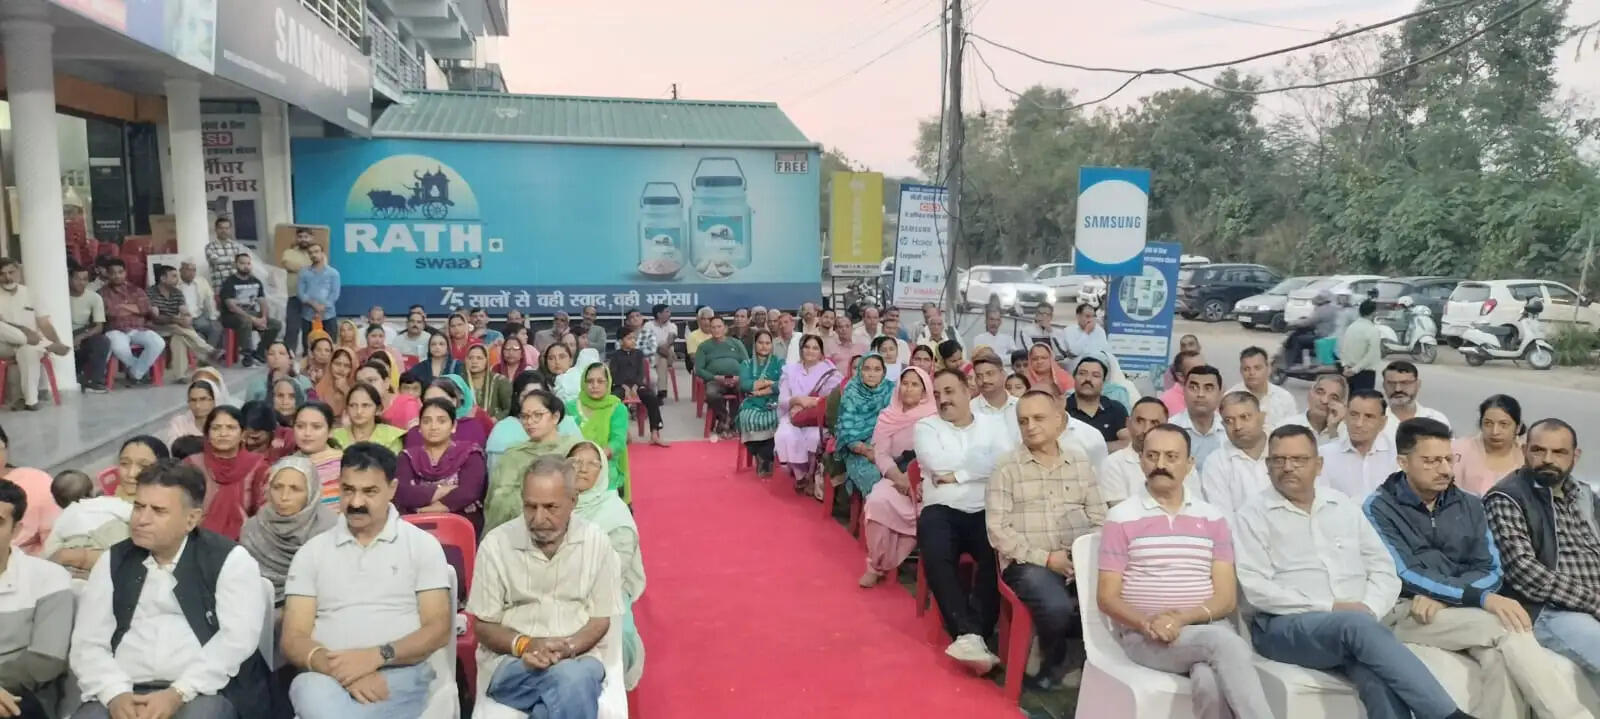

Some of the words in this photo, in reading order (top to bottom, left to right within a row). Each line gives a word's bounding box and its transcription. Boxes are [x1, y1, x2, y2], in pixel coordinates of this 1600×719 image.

[275, 8, 348, 96] SAMSUNG
[204, 133, 231, 146] SD
[777, 161, 806, 172] FREE
[1084, 215, 1142, 229] SAMSUNG
[344, 223, 483, 253] RATH
[416, 255, 482, 270] swaad
[440, 287, 464, 311] 75
[468, 289, 511, 308] सालों
[514, 289, 531, 308] से
[536, 290, 564, 307] वही
